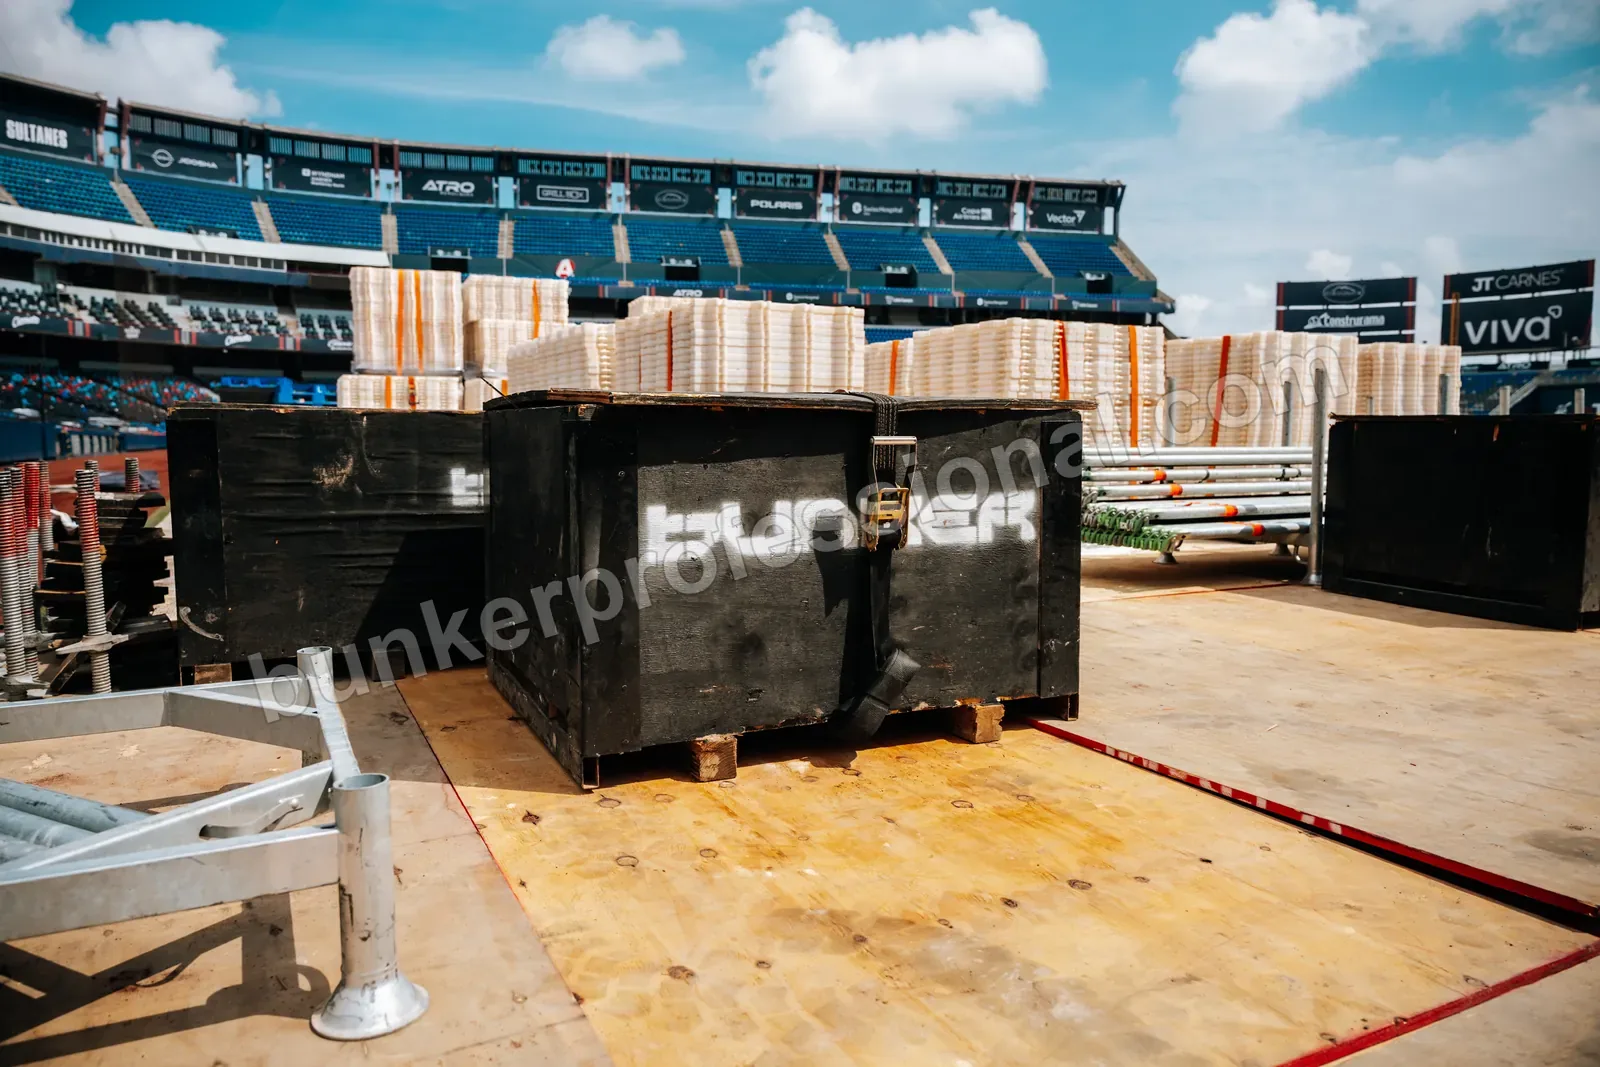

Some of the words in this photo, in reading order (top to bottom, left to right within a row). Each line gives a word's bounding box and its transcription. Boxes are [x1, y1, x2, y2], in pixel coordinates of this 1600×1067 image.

[6, 119, 68, 149] SULTANES
[422, 179, 475, 193] ATRO
[750, 199, 803, 210] POLARIS
[1046, 213, 1076, 224] Vector
[1471, 277, 1494, 292] JT
[1495, 270, 1560, 290] CARNES
[672, 289, 703, 297] ATRO
[1320, 312, 1385, 328] Construrama
